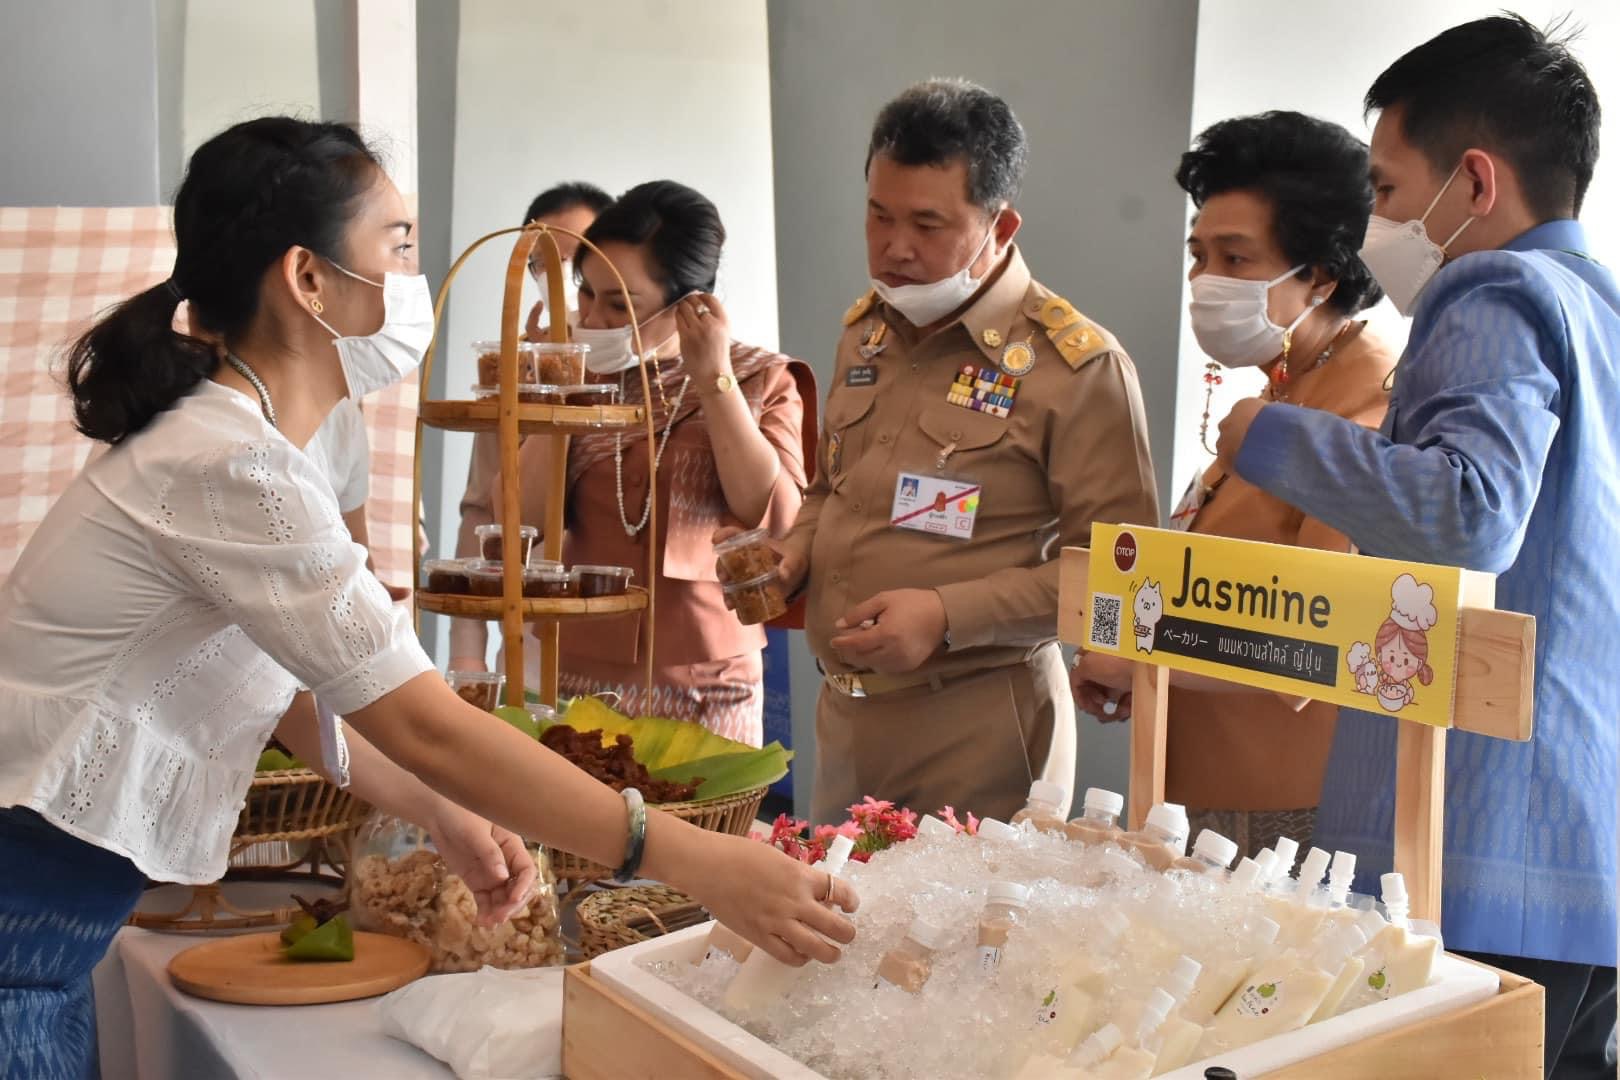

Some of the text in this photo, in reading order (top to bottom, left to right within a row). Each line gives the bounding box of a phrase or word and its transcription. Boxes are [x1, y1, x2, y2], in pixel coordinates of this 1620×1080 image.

[1116, 546, 1135, 557] OTOP
[1171, 546, 1331, 629] Jasmine
[1163, 628, 1209, 646] ベーカリー
